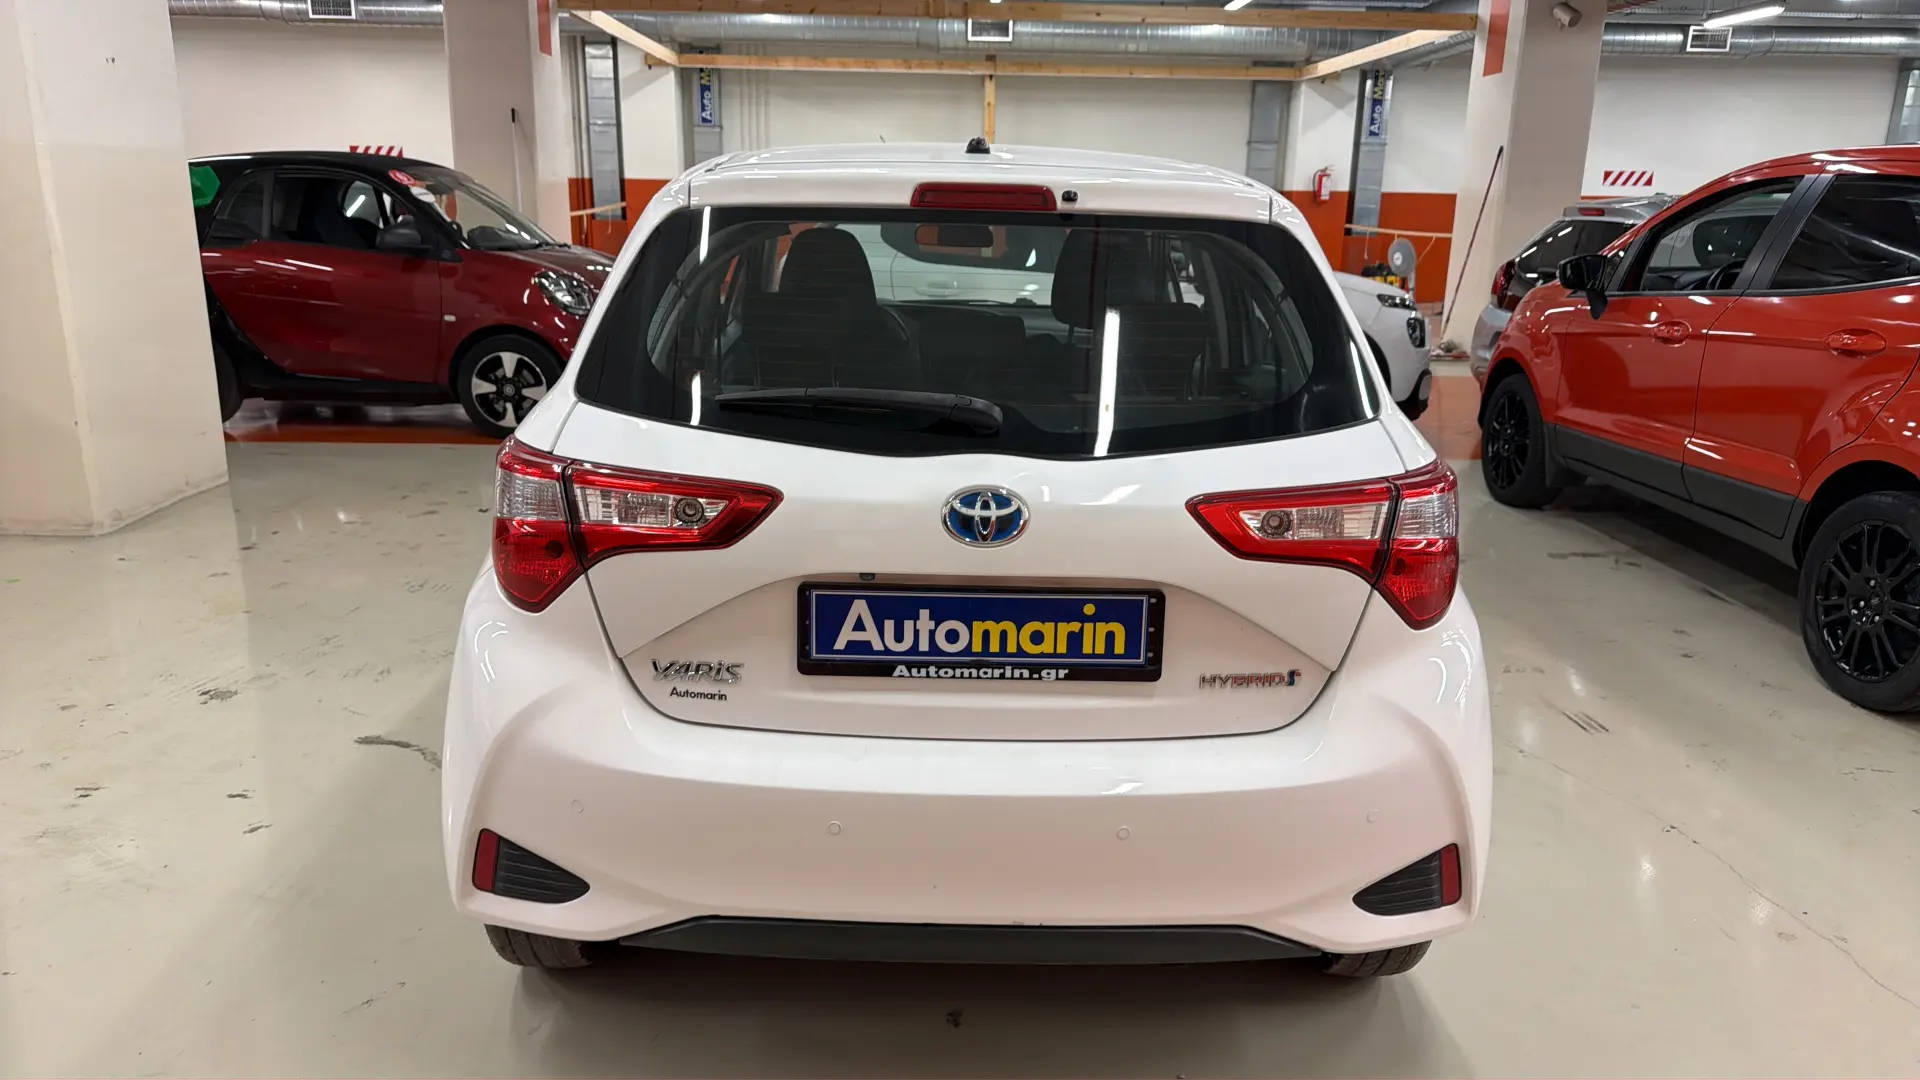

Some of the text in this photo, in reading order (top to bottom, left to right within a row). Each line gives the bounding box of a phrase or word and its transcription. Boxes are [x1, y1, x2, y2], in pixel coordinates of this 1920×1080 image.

[701, 90, 712, 120] Auto
[1370, 105, 1382, 134] Auto
[833, 599, 1126, 655] Automarin
[892, 664, 1069, 681] Automarin.gr
[1199, 673, 1286, 688] HYBRID
[669, 686, 727, 701] Automarin
